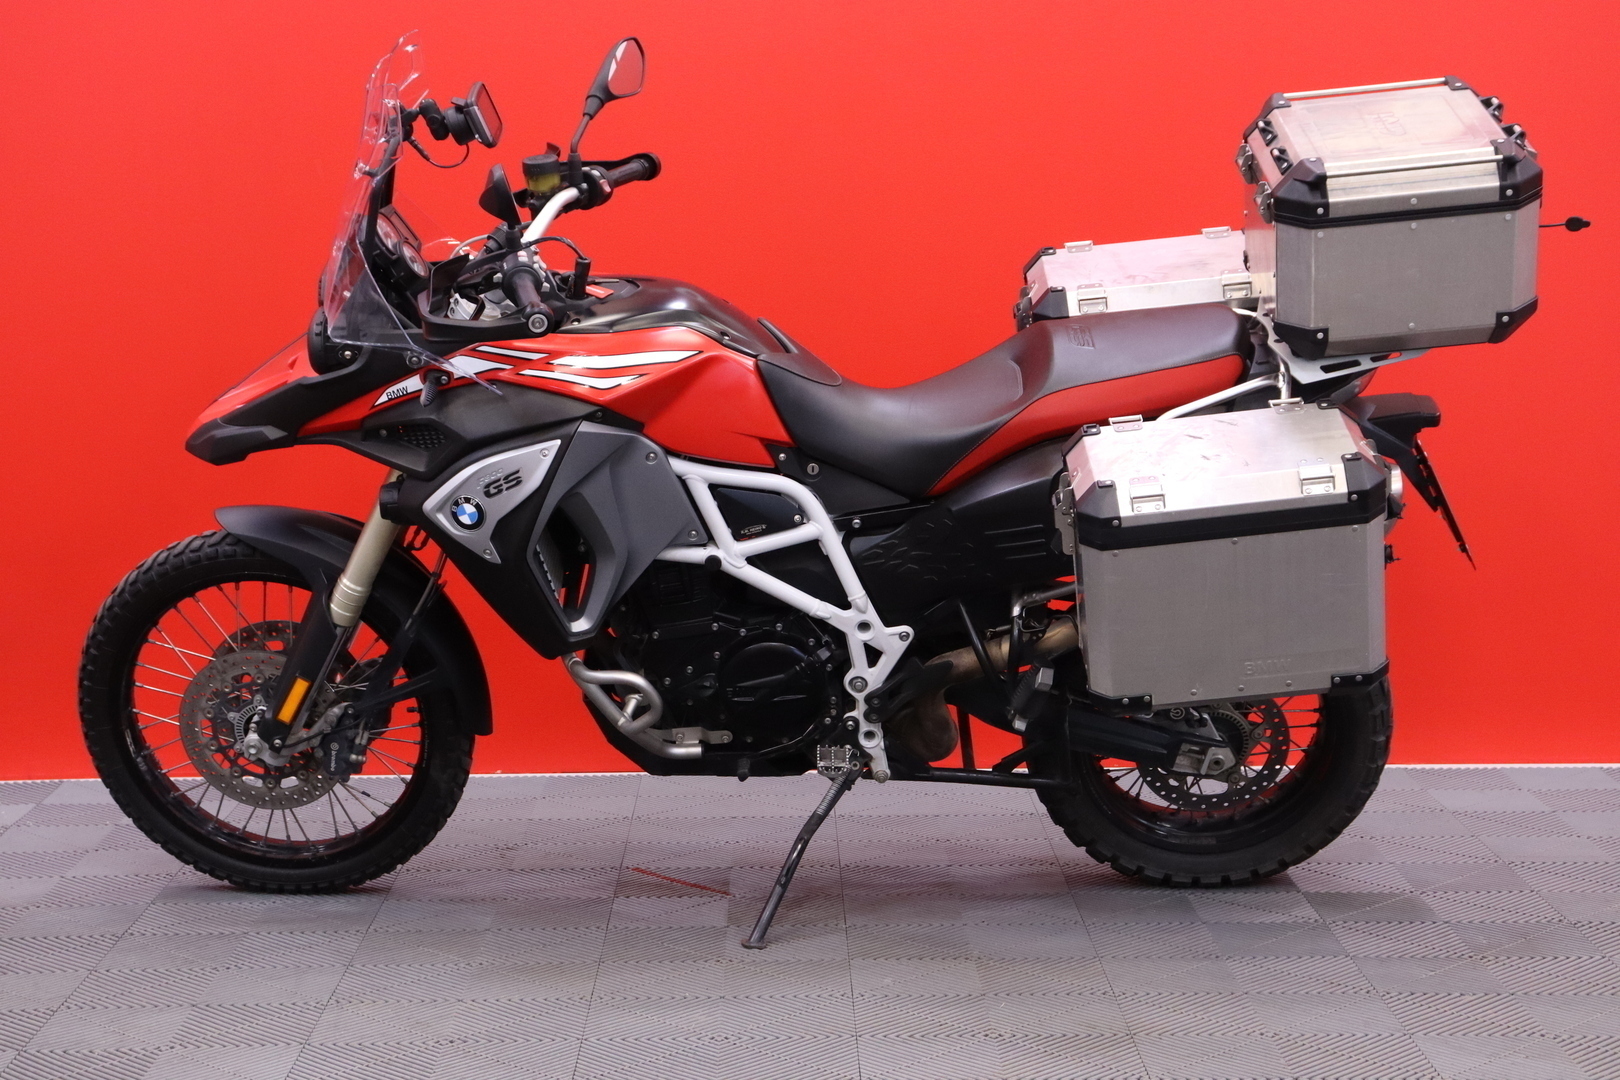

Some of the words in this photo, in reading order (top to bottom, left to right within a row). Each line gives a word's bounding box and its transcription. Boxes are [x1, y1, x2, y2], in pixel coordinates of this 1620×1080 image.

[385, 385, 410, 401] BMW
[483, 468, 524, 499] GS
[1243, 658, 1292, 676] BMW
